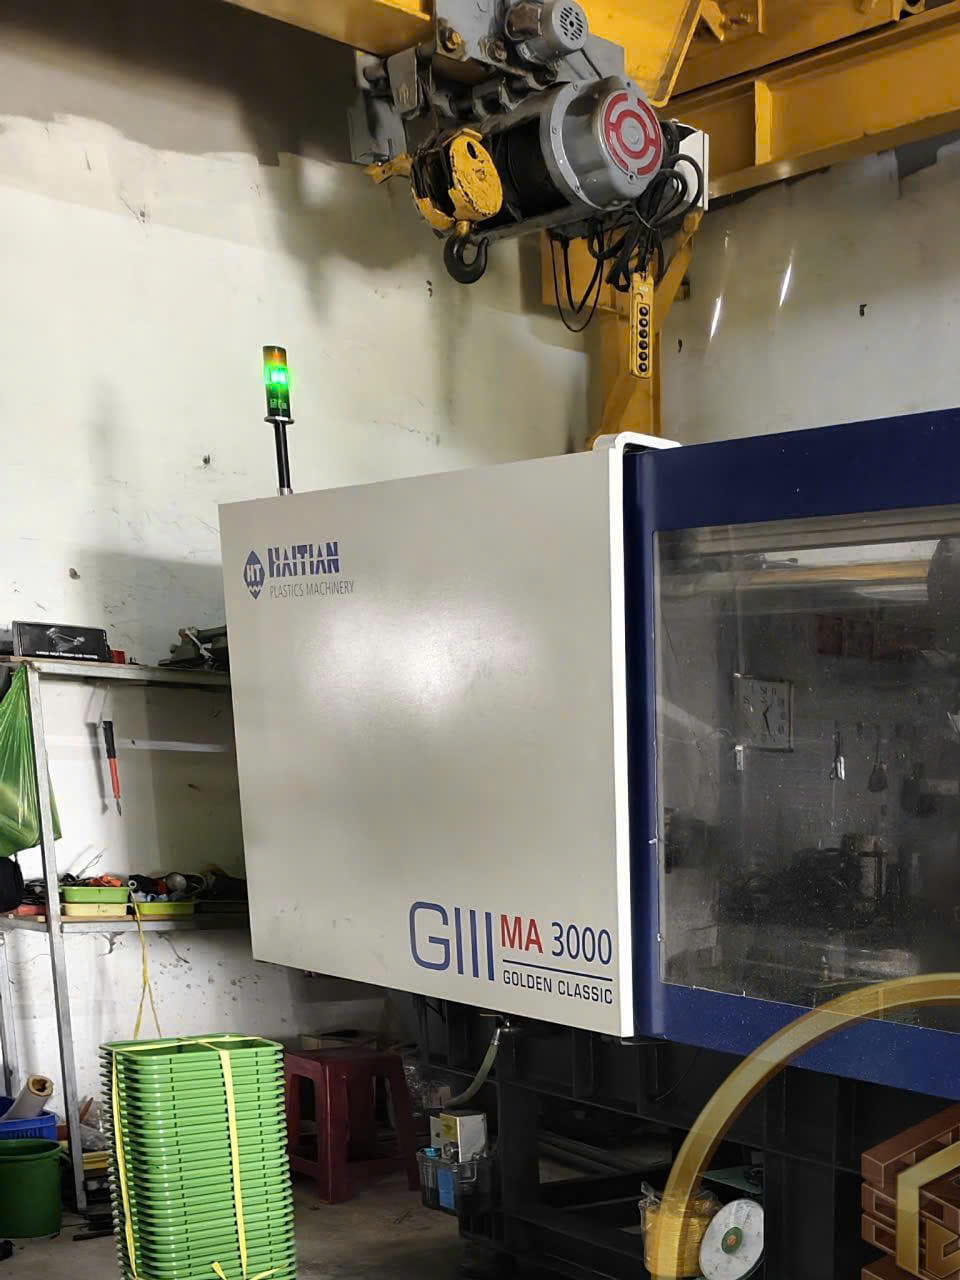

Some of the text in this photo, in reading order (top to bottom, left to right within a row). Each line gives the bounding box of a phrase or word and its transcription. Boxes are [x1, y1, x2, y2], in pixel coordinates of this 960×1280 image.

[267, 541, 340, 578] HAITIAN
[269, 580, 355, 599] PLASTICS MACHINERY
[500, 914, 544, 954] MA
[551, 922, 613, 965] 3000
[503, 970, 614, 1005] GOLDEN CLASSIC
